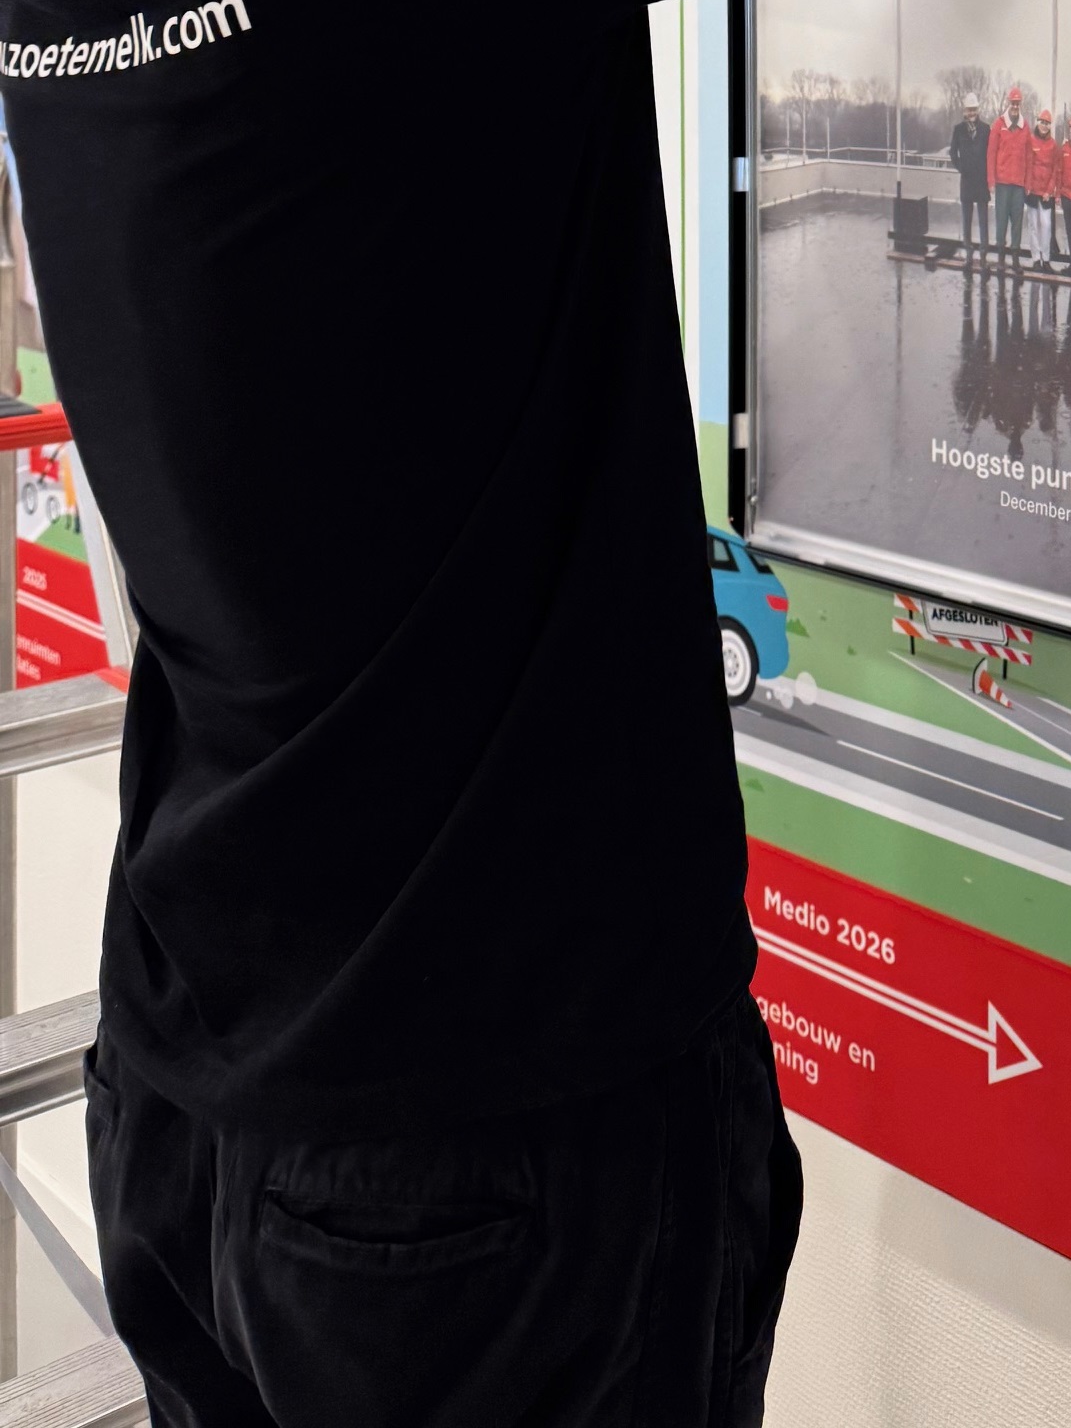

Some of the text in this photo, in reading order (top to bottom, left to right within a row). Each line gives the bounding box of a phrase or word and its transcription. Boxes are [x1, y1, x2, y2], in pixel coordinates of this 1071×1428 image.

[931, 438, 1025, 479] Hoogste
[1000, 490, 1071, 522] December
[763, 886, 897, 966] Medio 2026
[848, 1040, 876, 1072] en
